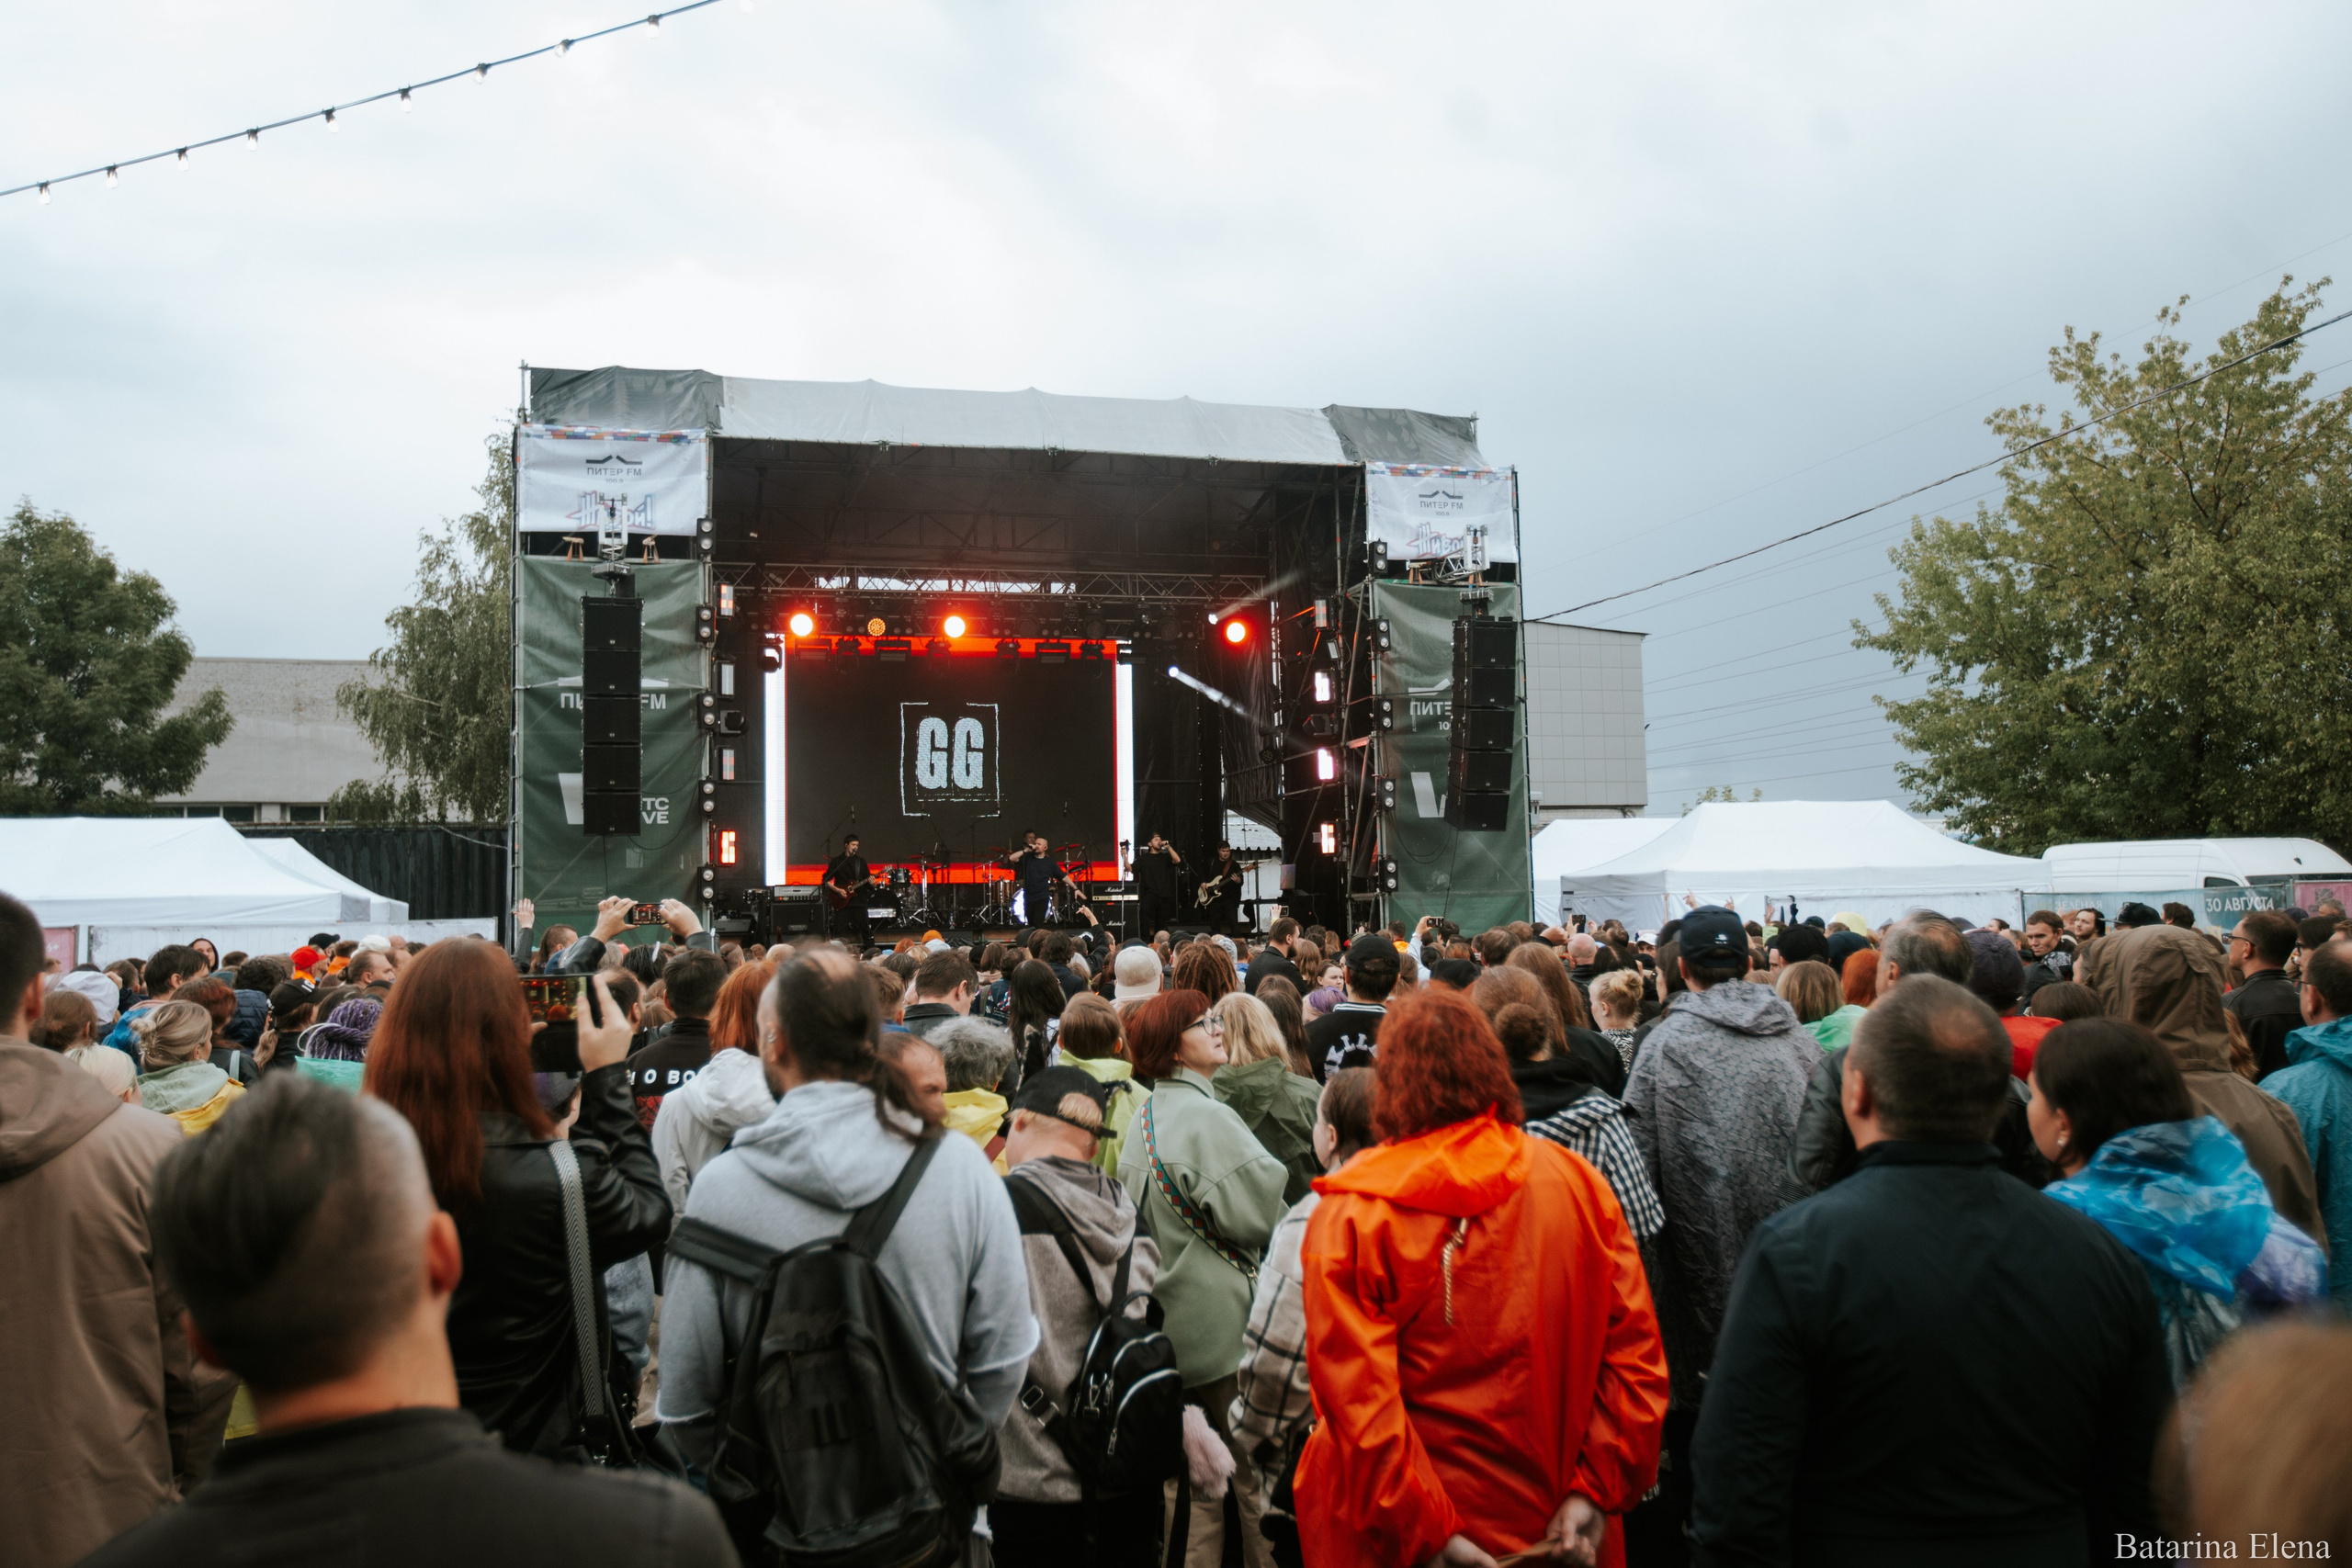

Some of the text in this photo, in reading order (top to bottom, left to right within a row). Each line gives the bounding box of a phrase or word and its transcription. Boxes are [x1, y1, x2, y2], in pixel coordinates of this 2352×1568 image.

[627, 468, 642, 477] FM
[1451, 502, 1464, 510] FM
[1409, 702, 1452, 716] ПИТЕ
[916, 717, 984, 789] GG
[2206, 897, 2274, 912] 30 АВГУСТА
